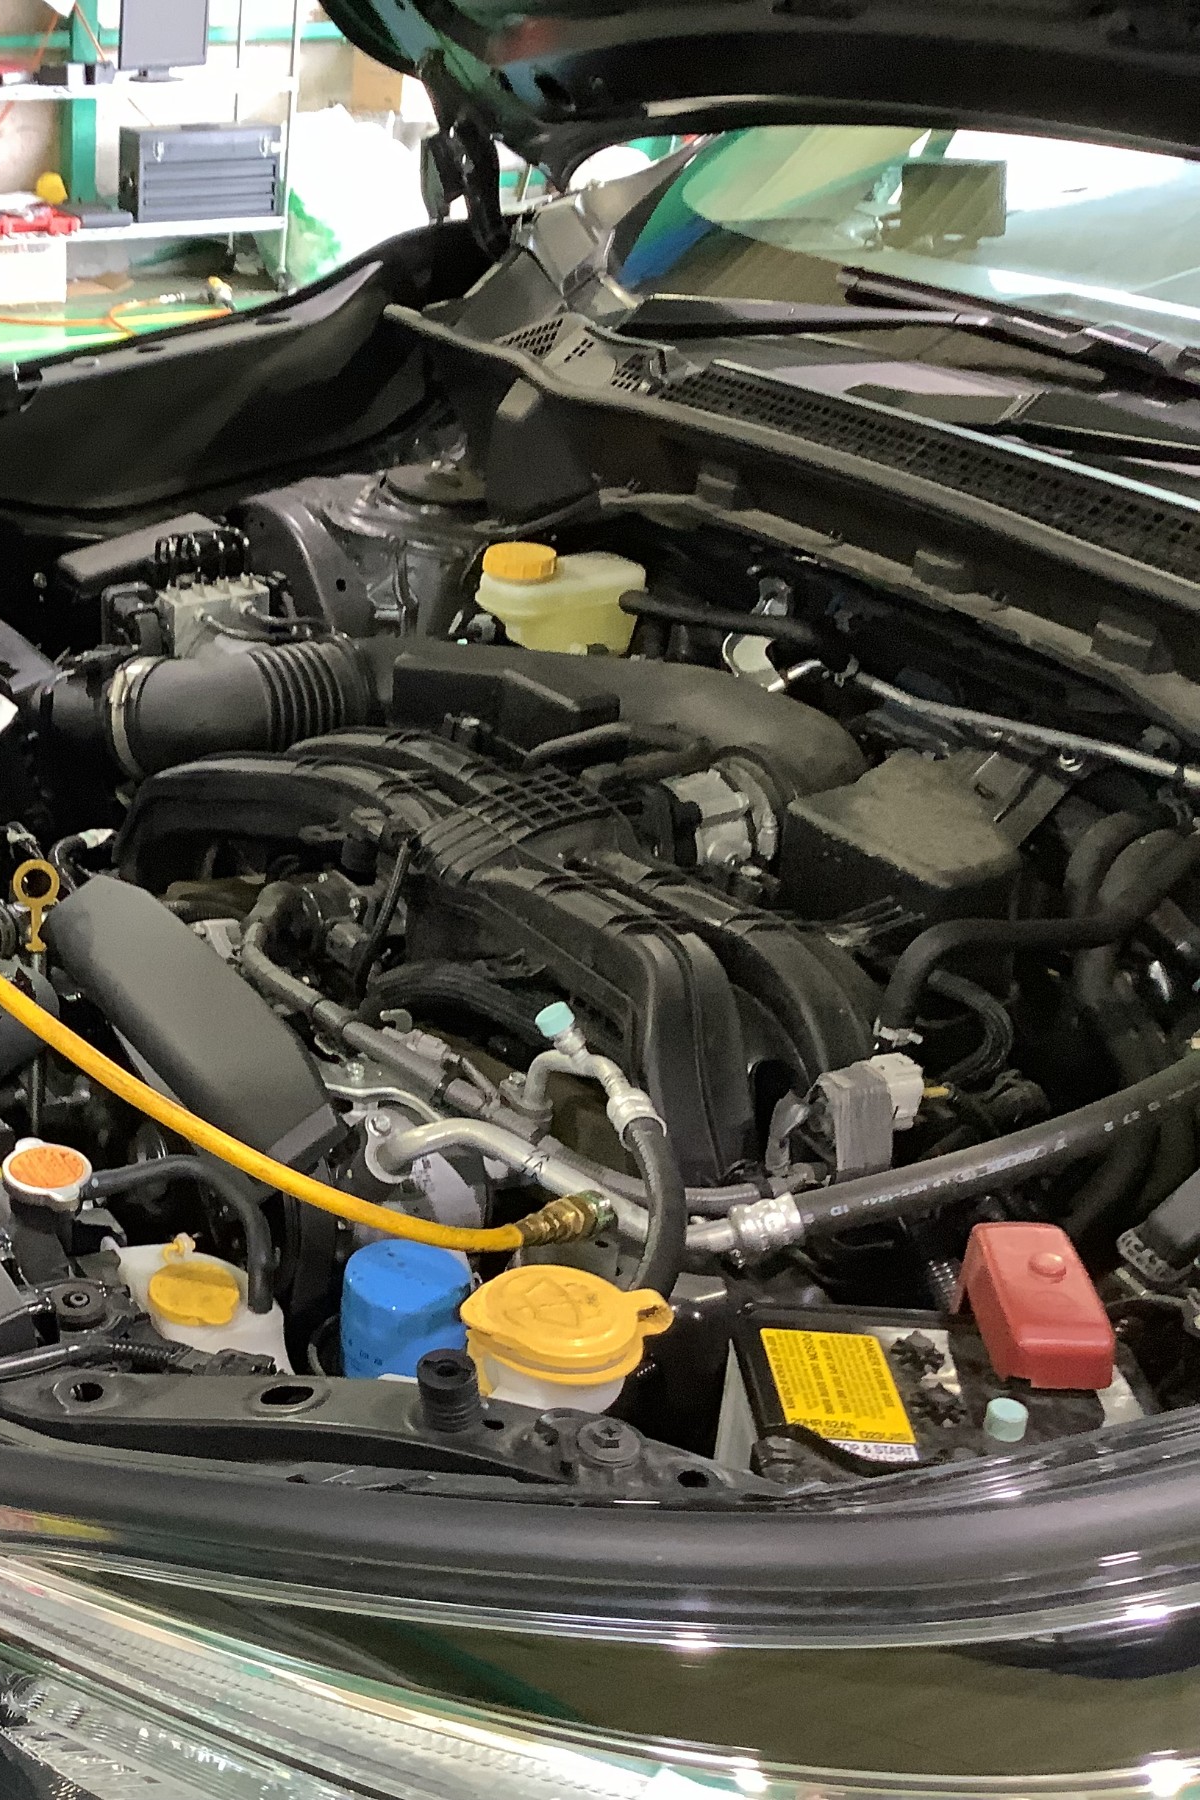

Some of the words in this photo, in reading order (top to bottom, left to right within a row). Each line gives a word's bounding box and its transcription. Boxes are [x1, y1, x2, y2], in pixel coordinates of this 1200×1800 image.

[801, 1333, 820, 1361] POISON
[861, 1337, 881, 1366] DANGER
[824, 1419, 857, 1430] 62Ah
[863, 1444, 871, 1454] &
[873, 1444, 912, 1456] START
